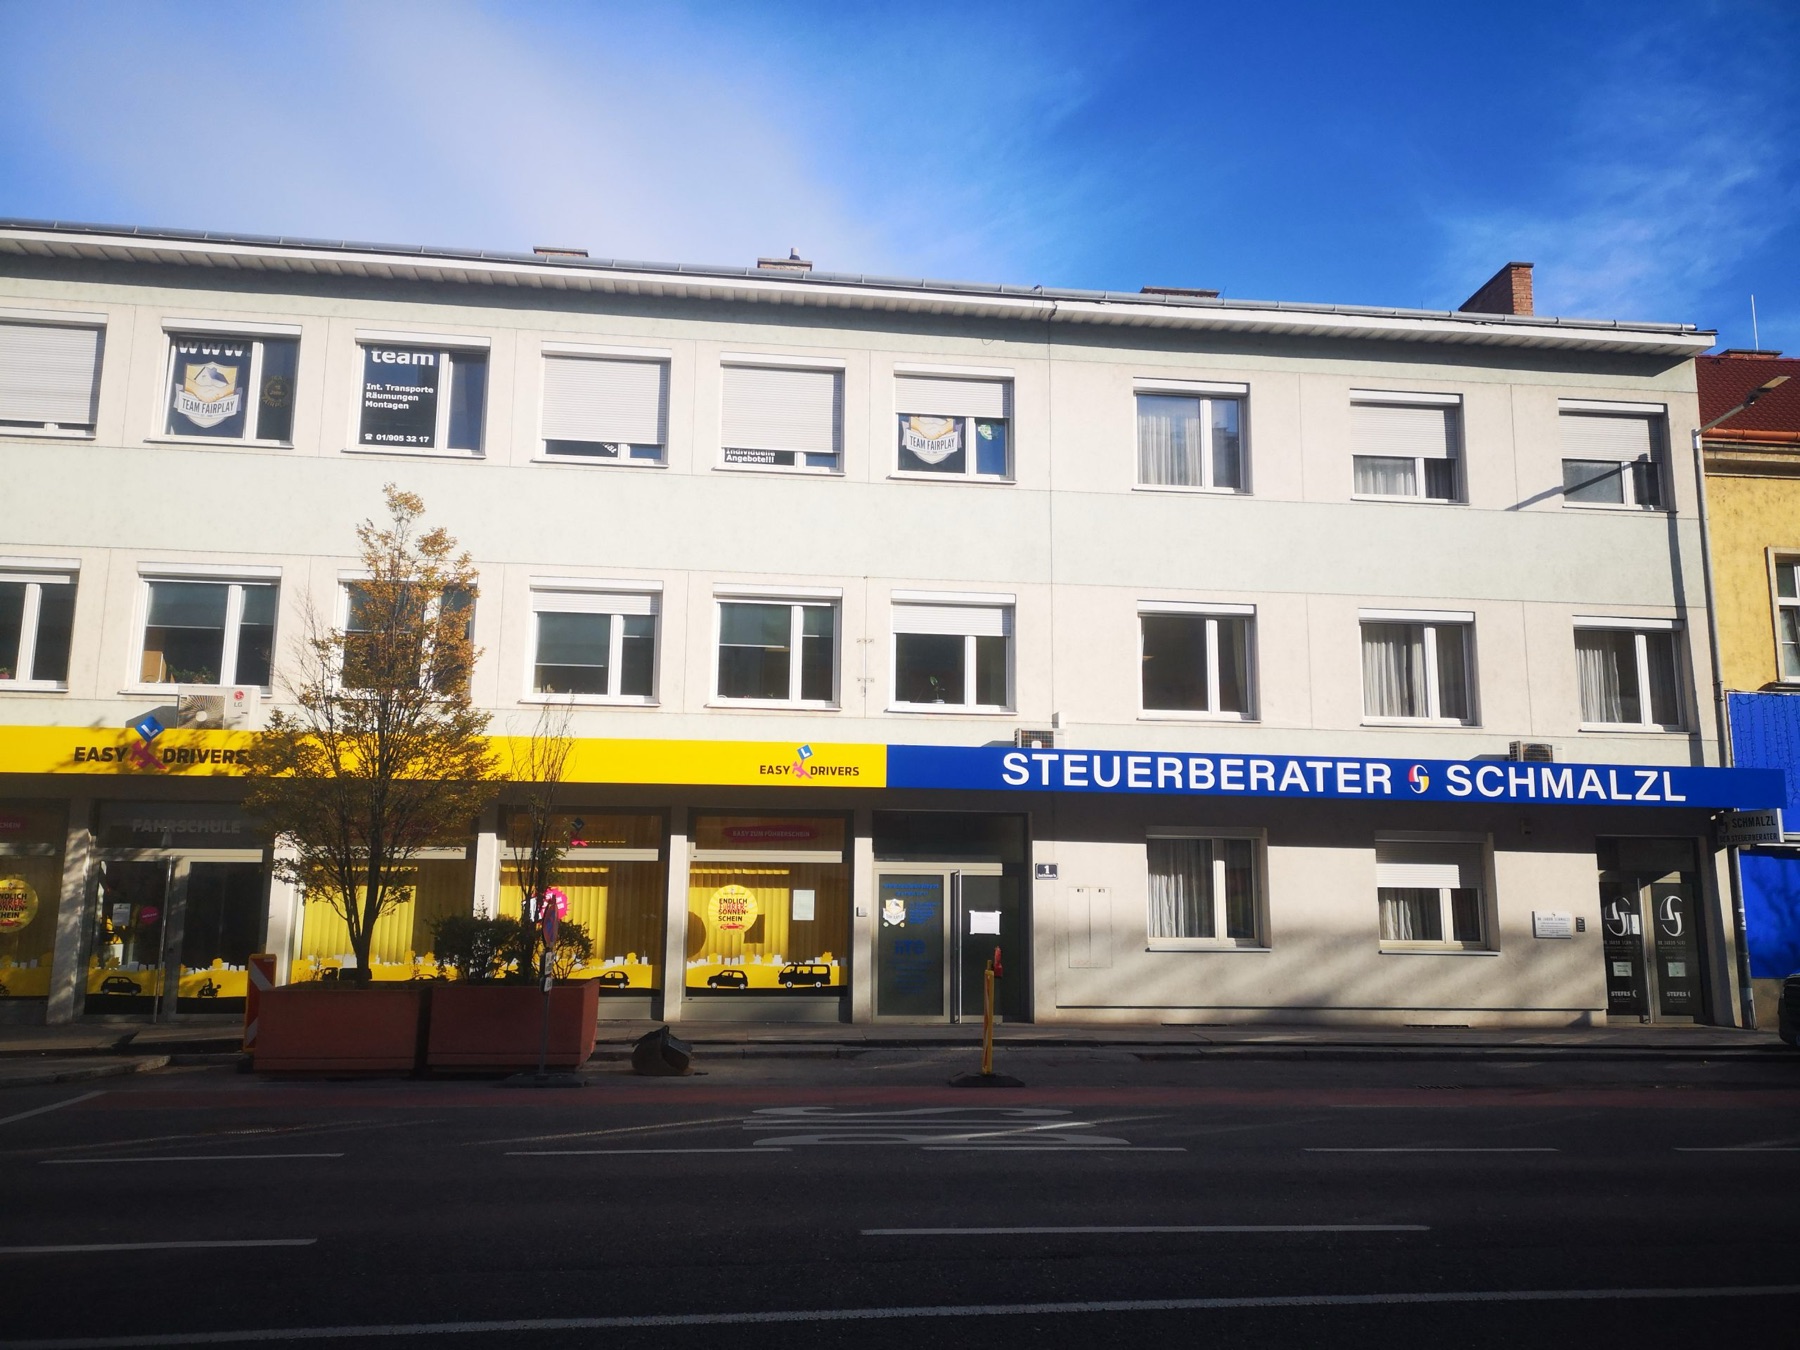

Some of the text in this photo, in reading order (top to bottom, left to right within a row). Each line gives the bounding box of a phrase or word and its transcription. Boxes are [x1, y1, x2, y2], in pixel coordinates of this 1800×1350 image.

[371, 348, 434, 366] team
[366, 383, 434, 394] Int. Transporte
[366, 391, 419, 402] Räumungen
[182, 398, 235, 414] TEAM FAIRPLAY
[365, 400, 409, 410] Montagen
[376, 433, 430, 443] 01/905 32 17
[909, 435, 955, 451] TEAM FAIRPLAY
[726, 454, 775, 464] Angebote!!!
[74, 746, 249, 765] EASY DRIVERS
[759, 765, 860, 777] EASY DRIVERS
[1002, 752, 1687, 802] STEUERBERATER SCHMALZL
[131, 819, 241, 834] FAHRSCHULE
[1732, 816, 1776, 828] SCHMALZL
[1044, 865, 1050, 874] 1
